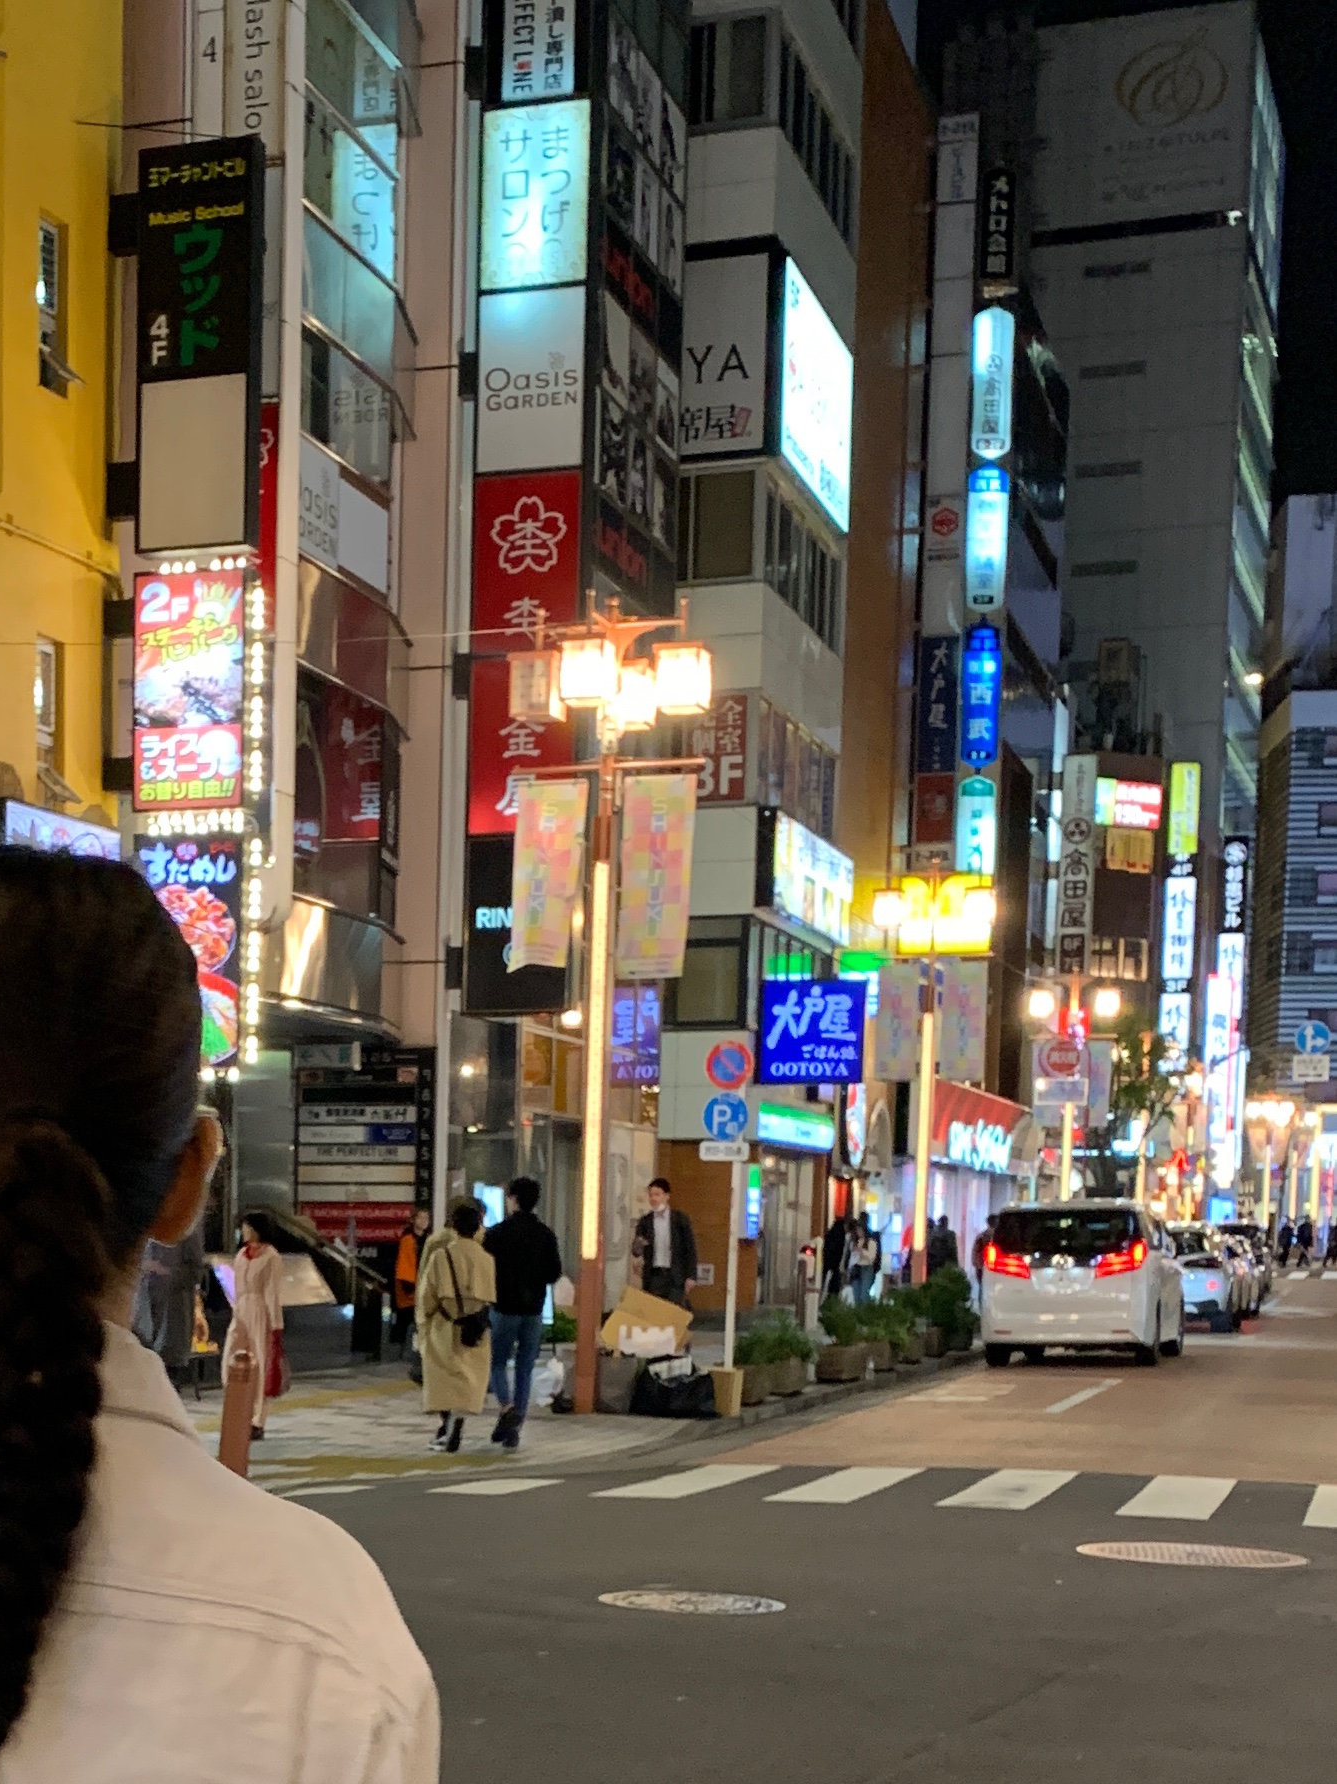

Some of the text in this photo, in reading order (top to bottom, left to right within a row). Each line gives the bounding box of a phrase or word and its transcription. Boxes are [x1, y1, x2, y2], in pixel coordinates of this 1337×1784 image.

[513, 0, 534, 46] FECT
[202, 36, 217, 63] 4
[244, 69, 270, 130] salo
[500, 128, 532, 238] サロン
[542, 125, 571, 235] まつげ
[149, 201, 245, 226] Music School
[173, 223, 224, 367] ウッド
[150, 314, 170, 367] 4F
[140, 581, 190, 622] 2F
[140, 734, 199, 759] ライス
[1061, 849, 1090, 928] 高田屋
[475, 905, 514, 930] RIN
[766, 985, 858, 1050] 大戸屋
[770, 1061, 849, 1077] OOTOYA
[713, 1104, 732, 1135] P
